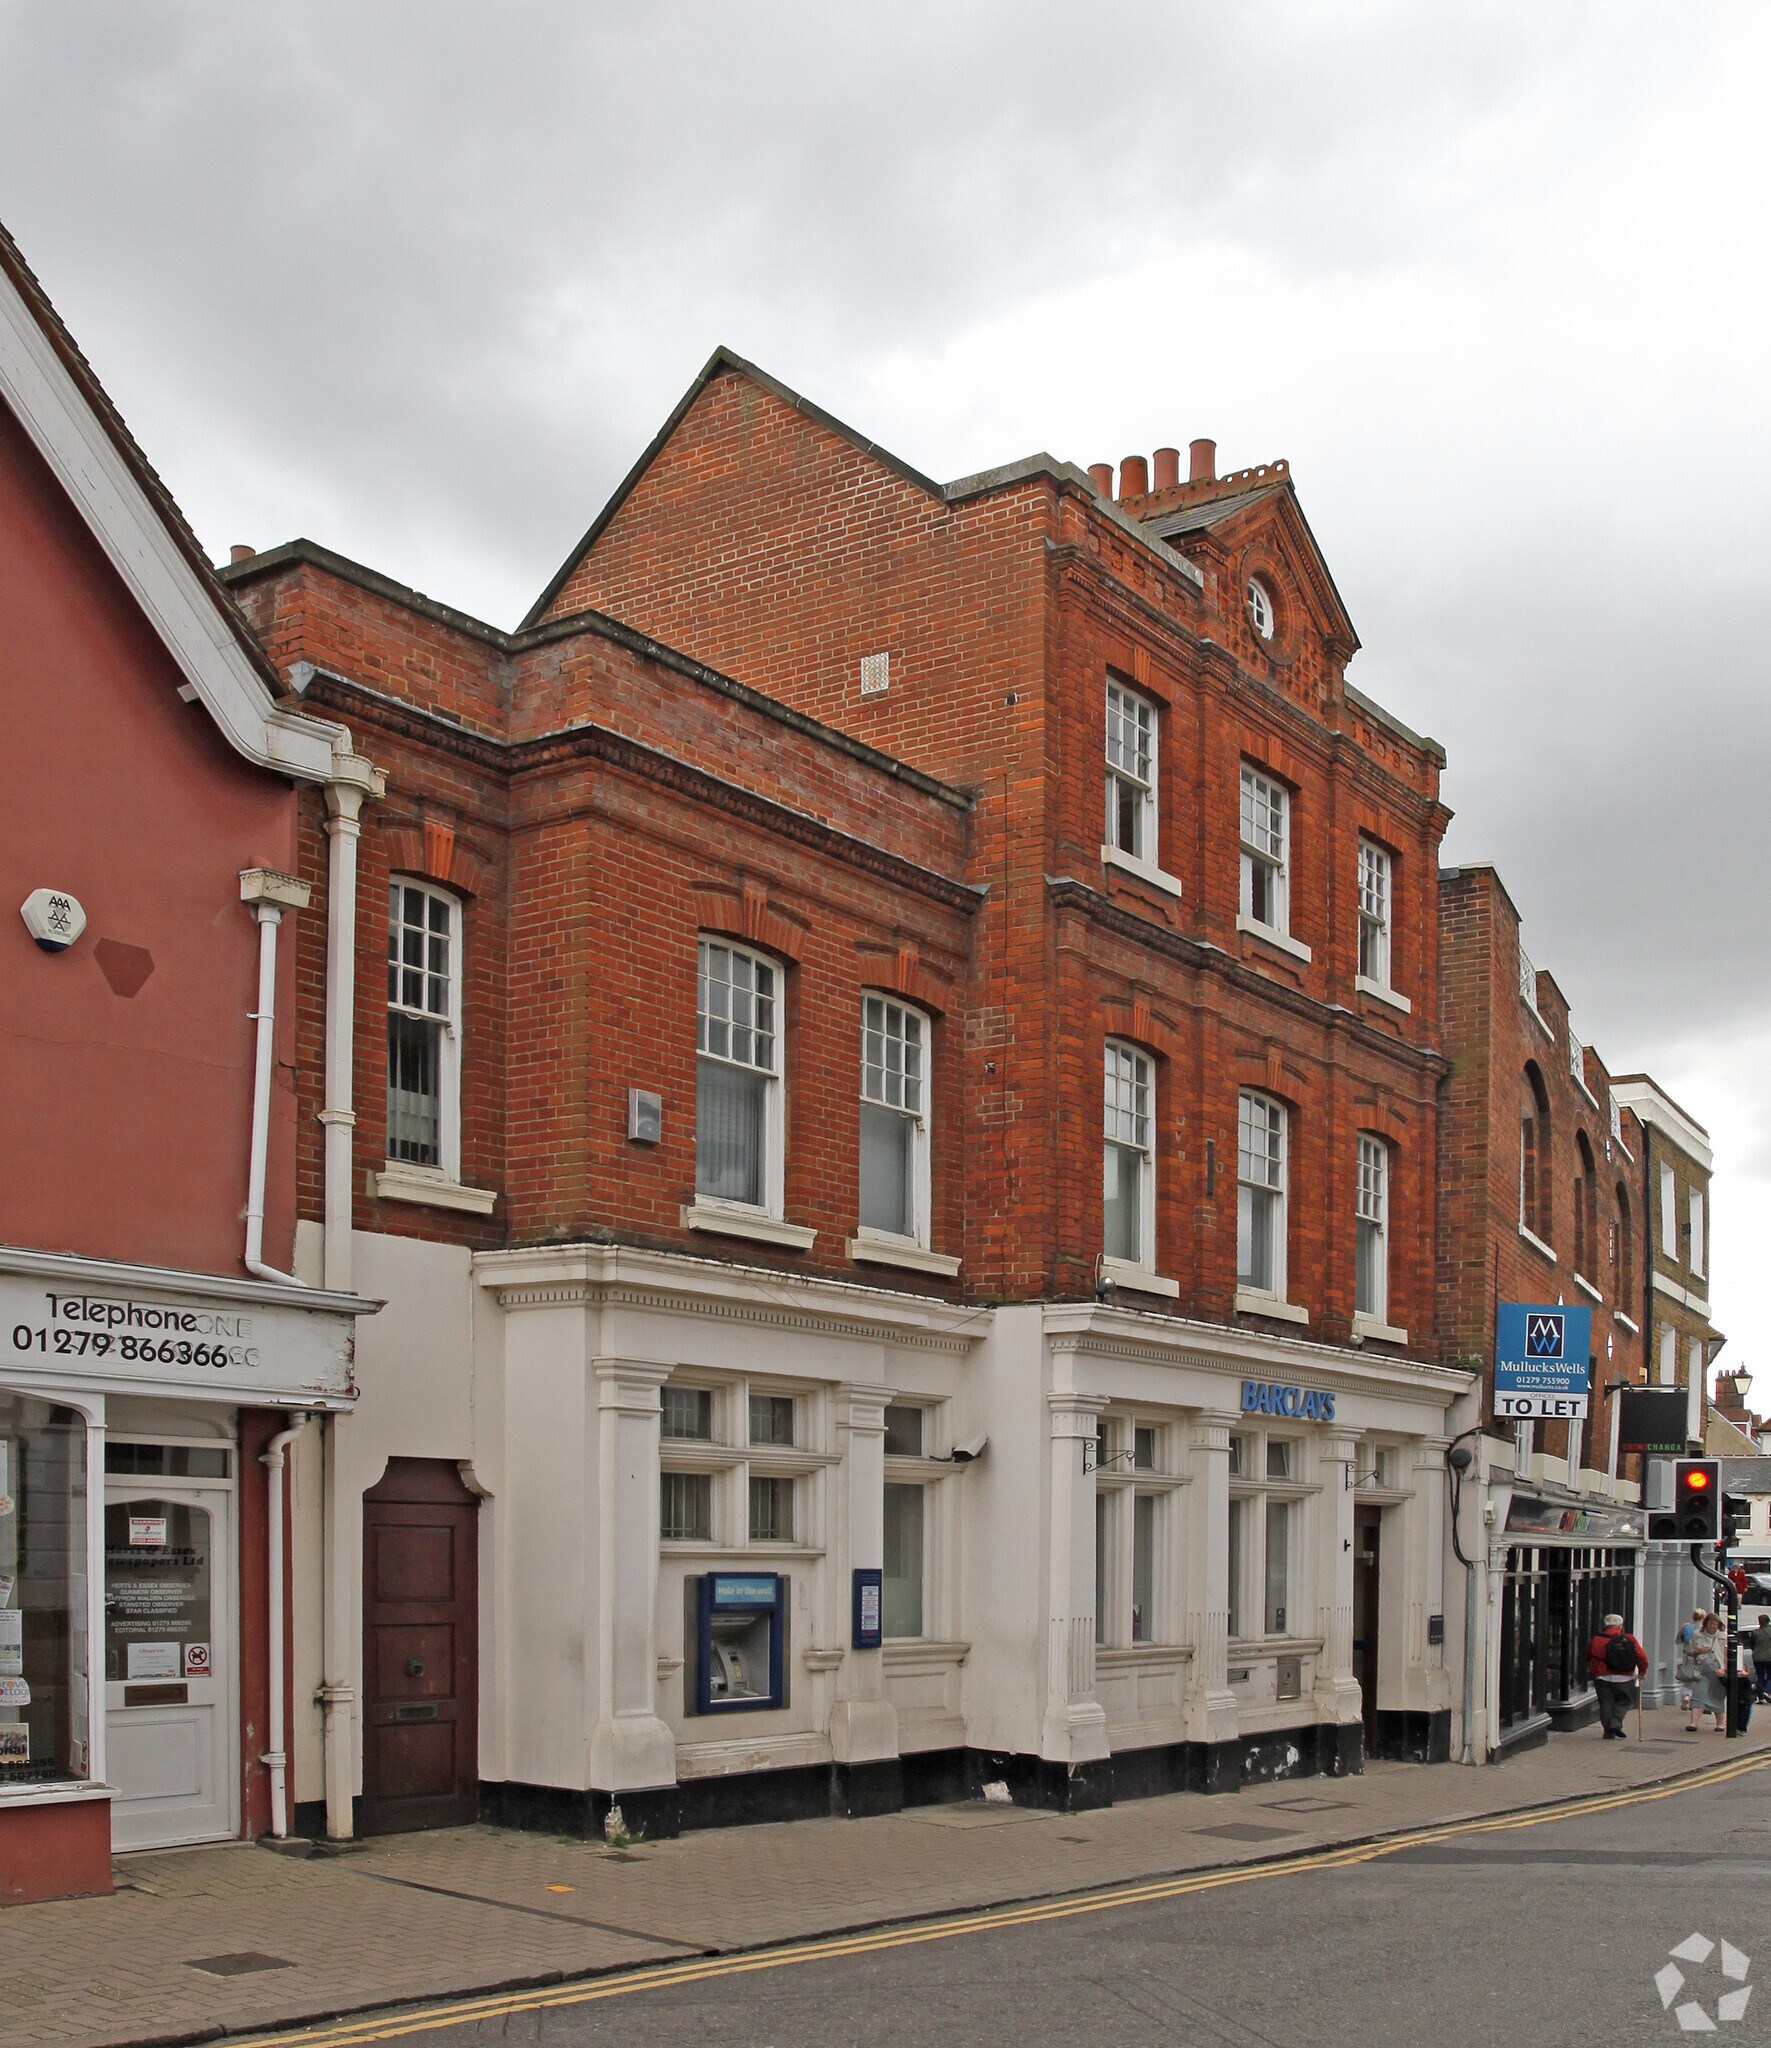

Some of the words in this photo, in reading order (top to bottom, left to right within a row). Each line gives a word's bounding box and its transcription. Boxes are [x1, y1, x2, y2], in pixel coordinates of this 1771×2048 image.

[46, 1293, 197, 1332] Telephone
[13, 1325, 111, 1357] 01279
[121, 1336, 228, 1368] 866366
[1501, 1361, 1586, 1374] MullucksWells
[1516, 1376, 1540, 1384] 01279
[1542, 1377, 1570, 1385] 755900
[1241, 1380, 1336, 1421] BARCLAYS
[1502, 1399, 1532, 1415] TO
[1541, 1400, 1580, 1416] LET
[162, 1546, 196, 1555] Essex
[106, 1557, 178, 1567] ewspapers
[183, 1556, 204, 1565] Ltd
